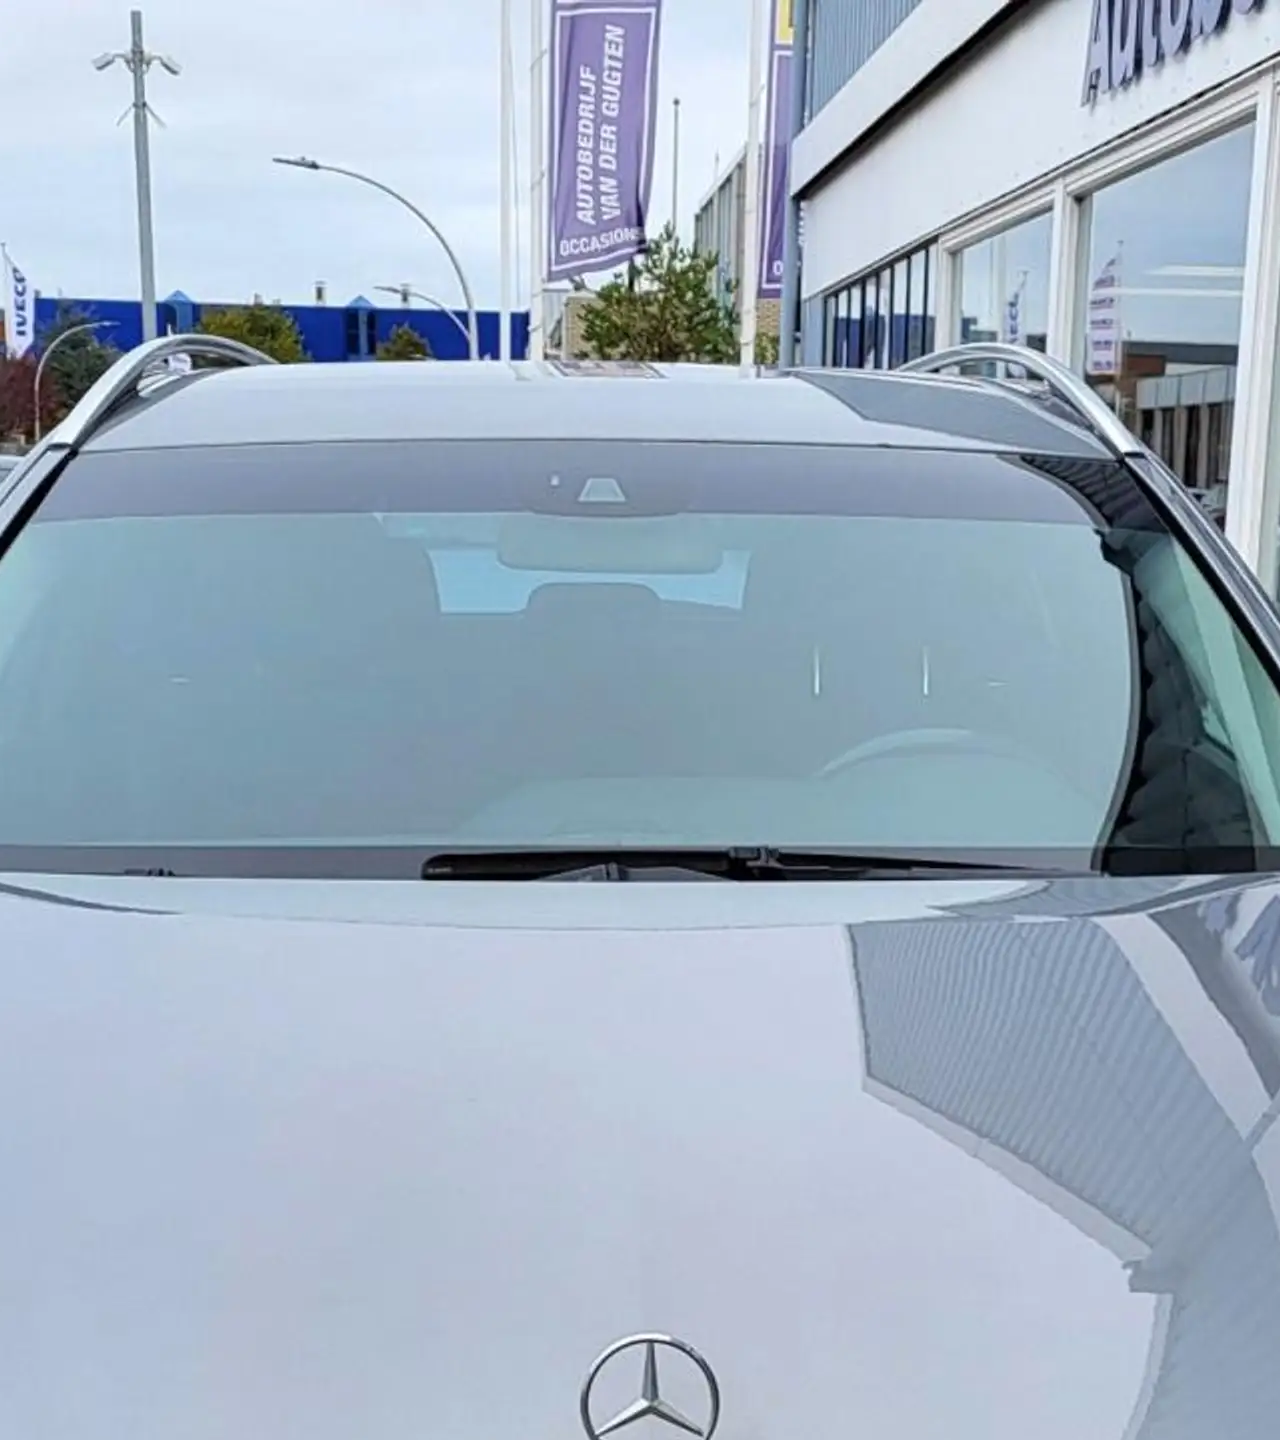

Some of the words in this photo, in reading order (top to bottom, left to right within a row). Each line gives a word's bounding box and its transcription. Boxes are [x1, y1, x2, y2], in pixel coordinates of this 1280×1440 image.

[602, 24, 625, 118] GUGTEN
[576, 63, 597, 225] AUTOBEDRIJF
[599, 123, 618, 171] DER
[599, 176, 621, 221] VAN
